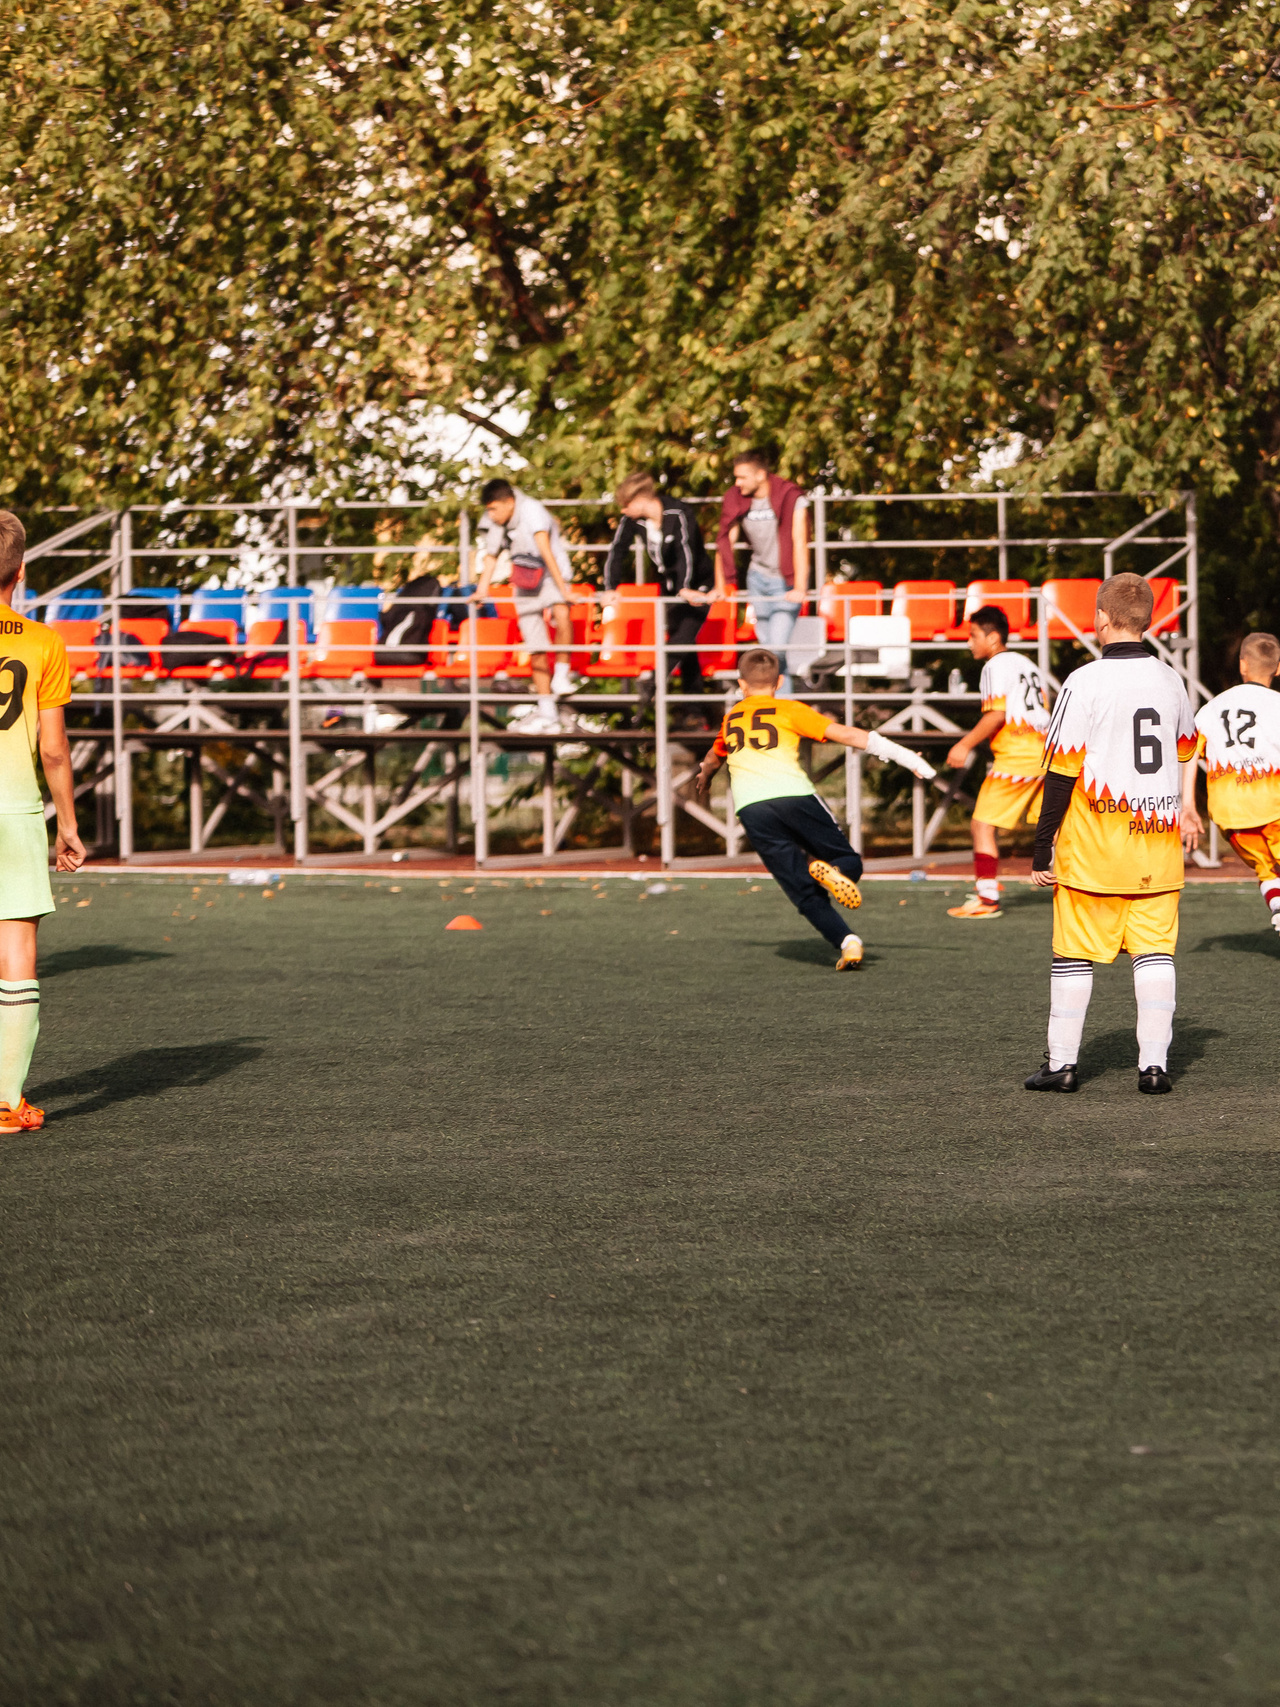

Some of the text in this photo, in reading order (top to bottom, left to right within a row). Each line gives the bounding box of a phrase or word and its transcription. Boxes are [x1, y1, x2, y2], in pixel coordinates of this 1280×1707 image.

[0, 620, 24, 635] ОВ
[725, 707, 779, 755] 55
[1133, 707, 1163, 775] 6
[1220, 708, 1257, 749] 12
[1128, 817, 1175, 836] РАЙОН
